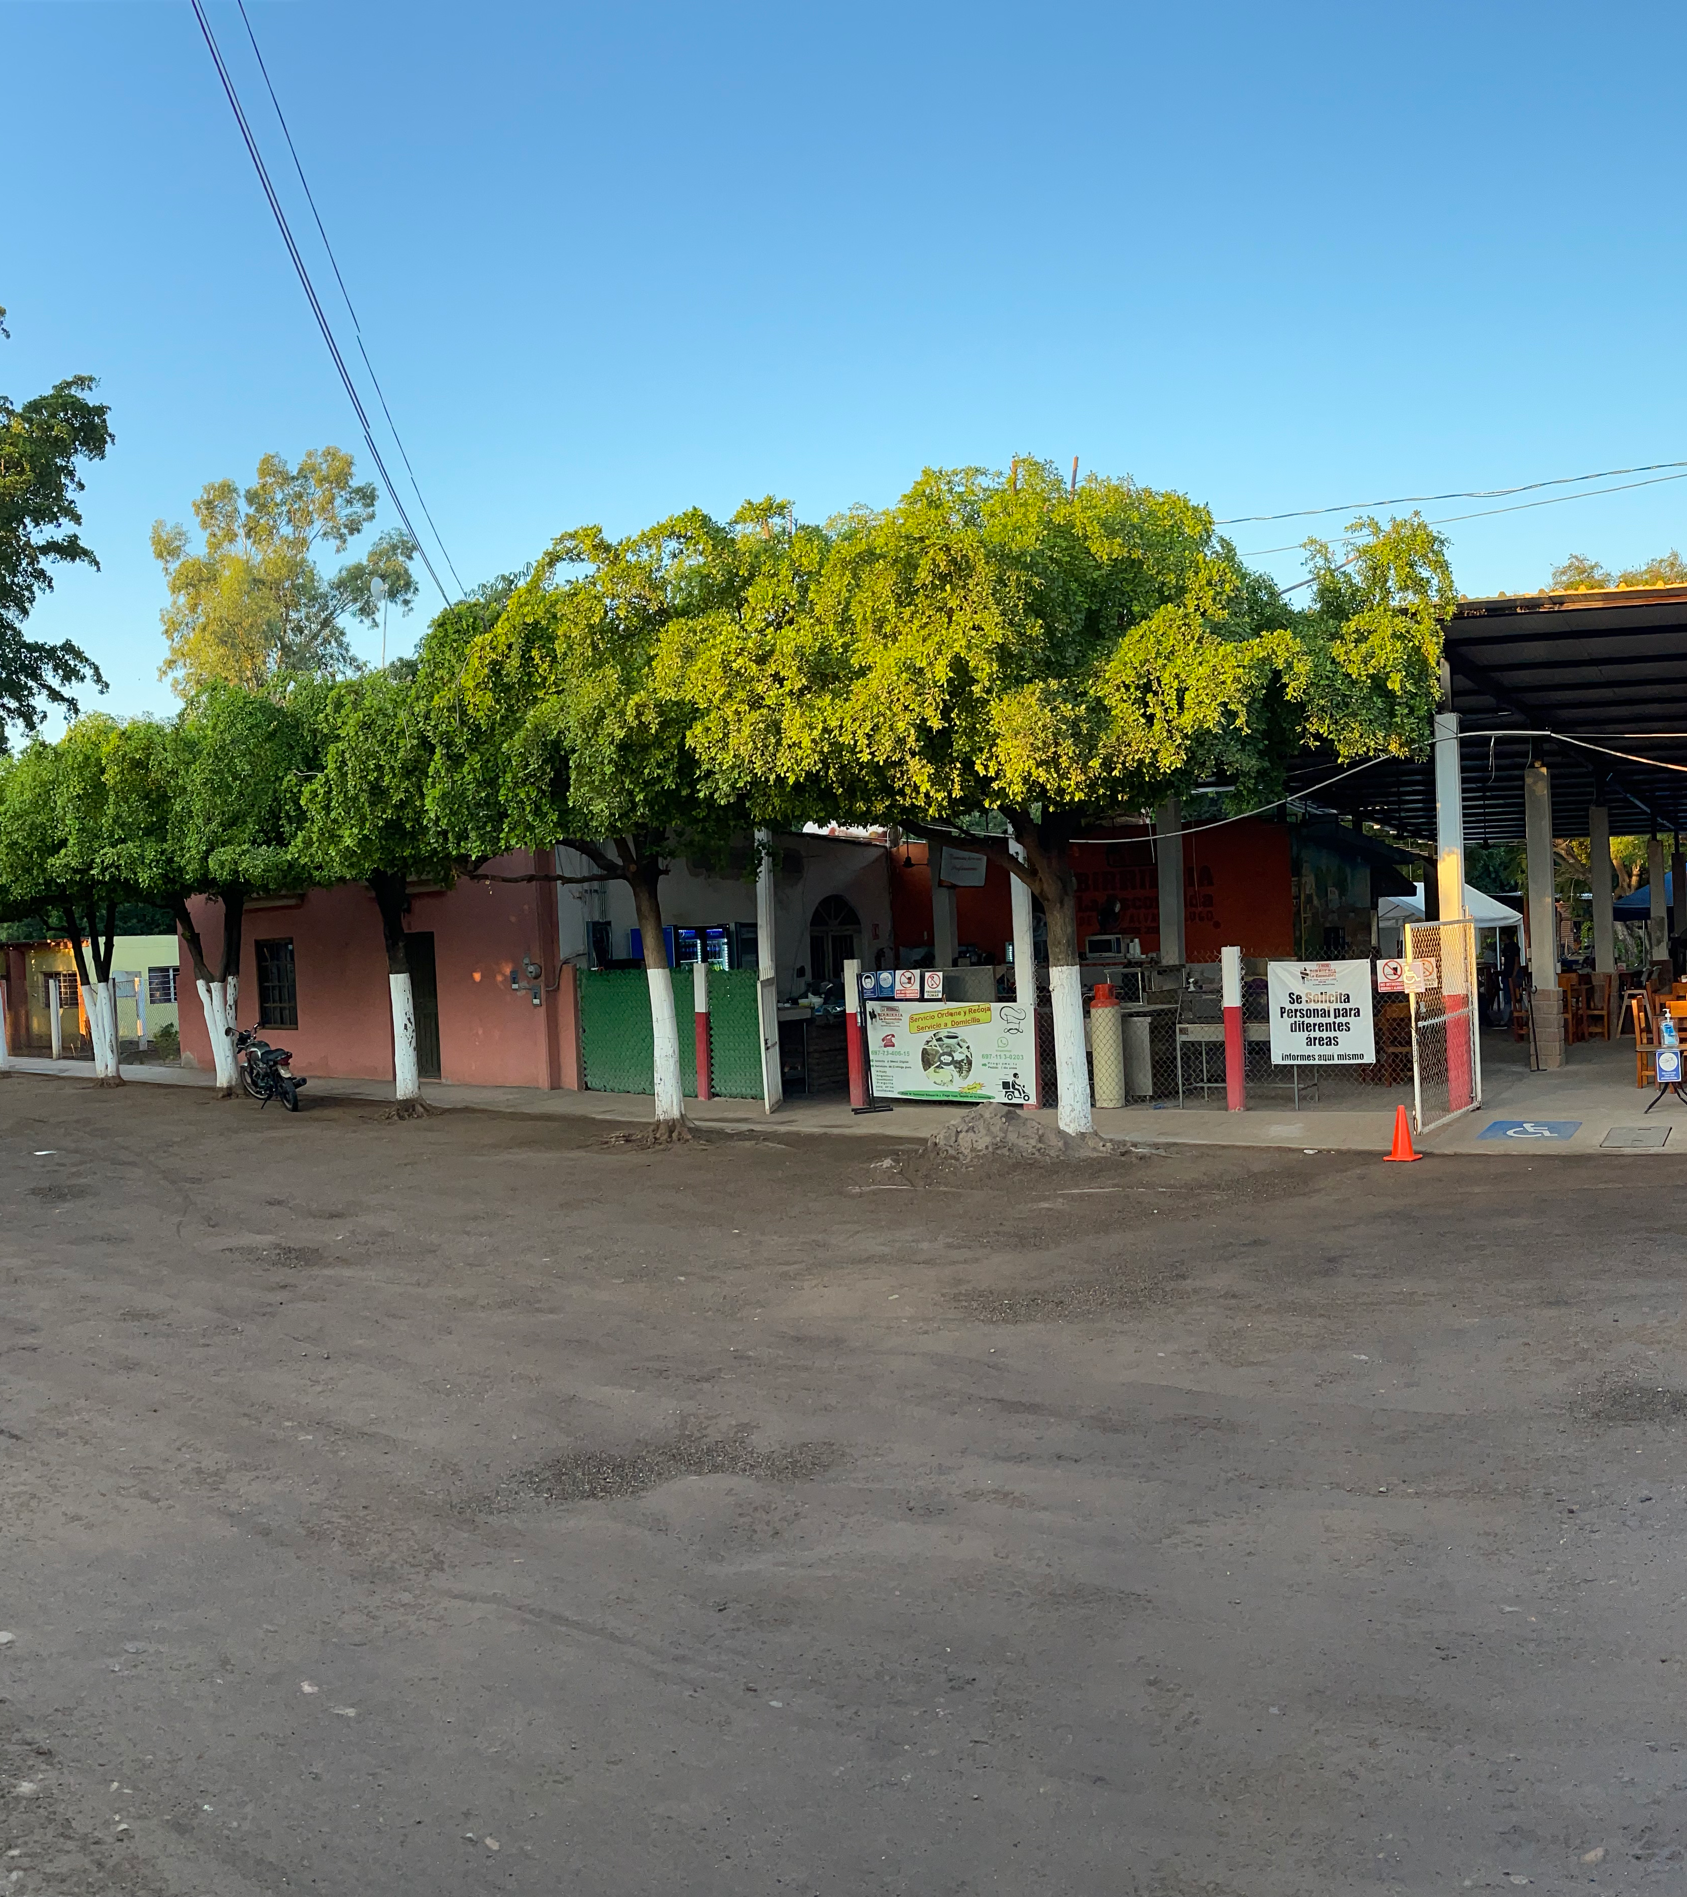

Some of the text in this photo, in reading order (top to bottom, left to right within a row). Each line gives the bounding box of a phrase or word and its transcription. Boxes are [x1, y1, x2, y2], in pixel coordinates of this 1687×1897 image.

[1074, 865, 1214, 892] BIRRIEIA
[1288, 991, 1351, 1005] Se Solicita
[910, 1014, 936, 1023] Servicio
[936, 1010, 962, 1018] Ordene
[968, 1006, 991, 1015] Recoja
[1279, 1006, 1361, 1020] Personal para
[916, 1022, 942, 1032] Servicio
[950, 1016, 981, 1027] Domicilio
[1290, 1020, 1351, 1033] diferentes
[1305, 1034, 1339, 1047] áreas
[1317, 1052, 1335, 1062] aquí
[1337, 1052, 1364, 1061] mismo
